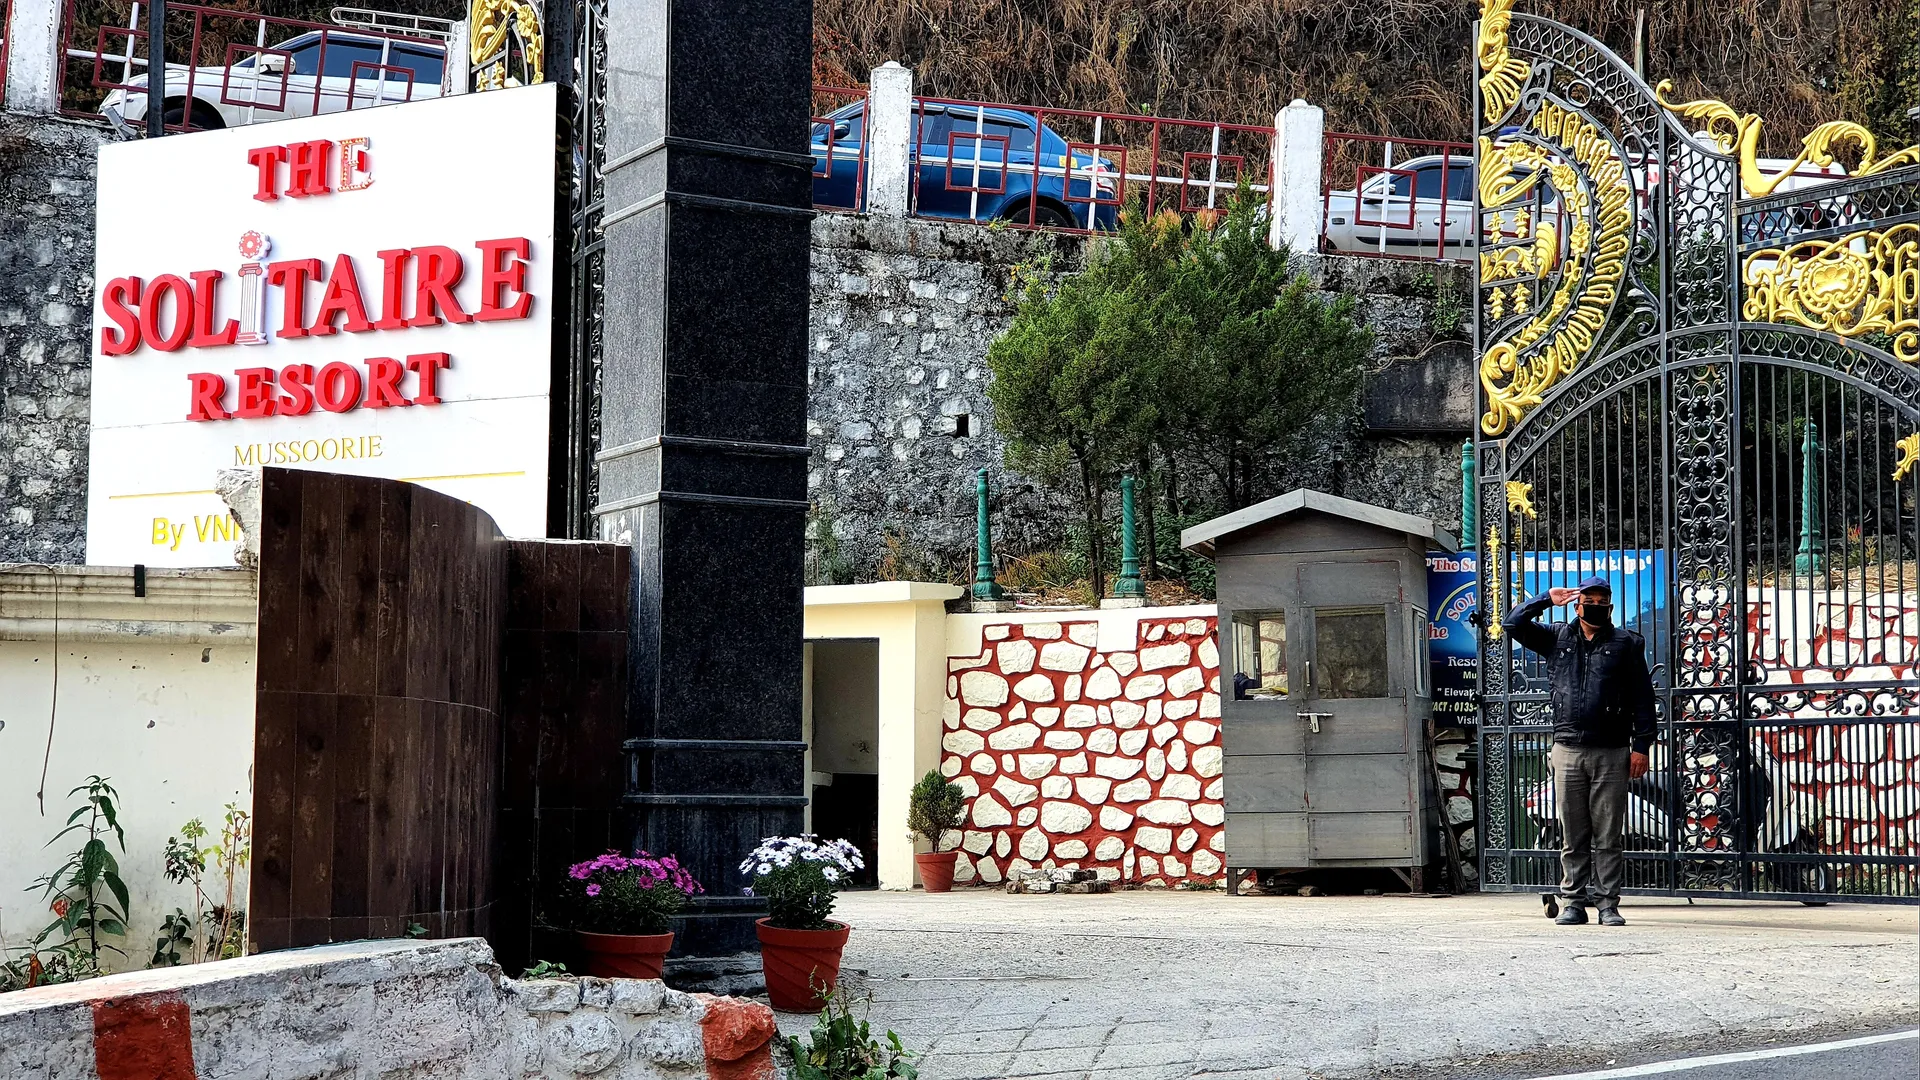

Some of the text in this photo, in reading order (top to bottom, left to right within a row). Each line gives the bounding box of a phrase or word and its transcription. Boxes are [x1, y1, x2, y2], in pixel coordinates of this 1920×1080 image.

[248, 137, 374, 202] THE
[186, 352, 452, 423] RESORT
[234, 435, 384, 467] MUSSOORIE
[152, 517, 186, 551] By
[1428, 622, 1449, 640] he
[1447, 656, 1478, 667] Reso
